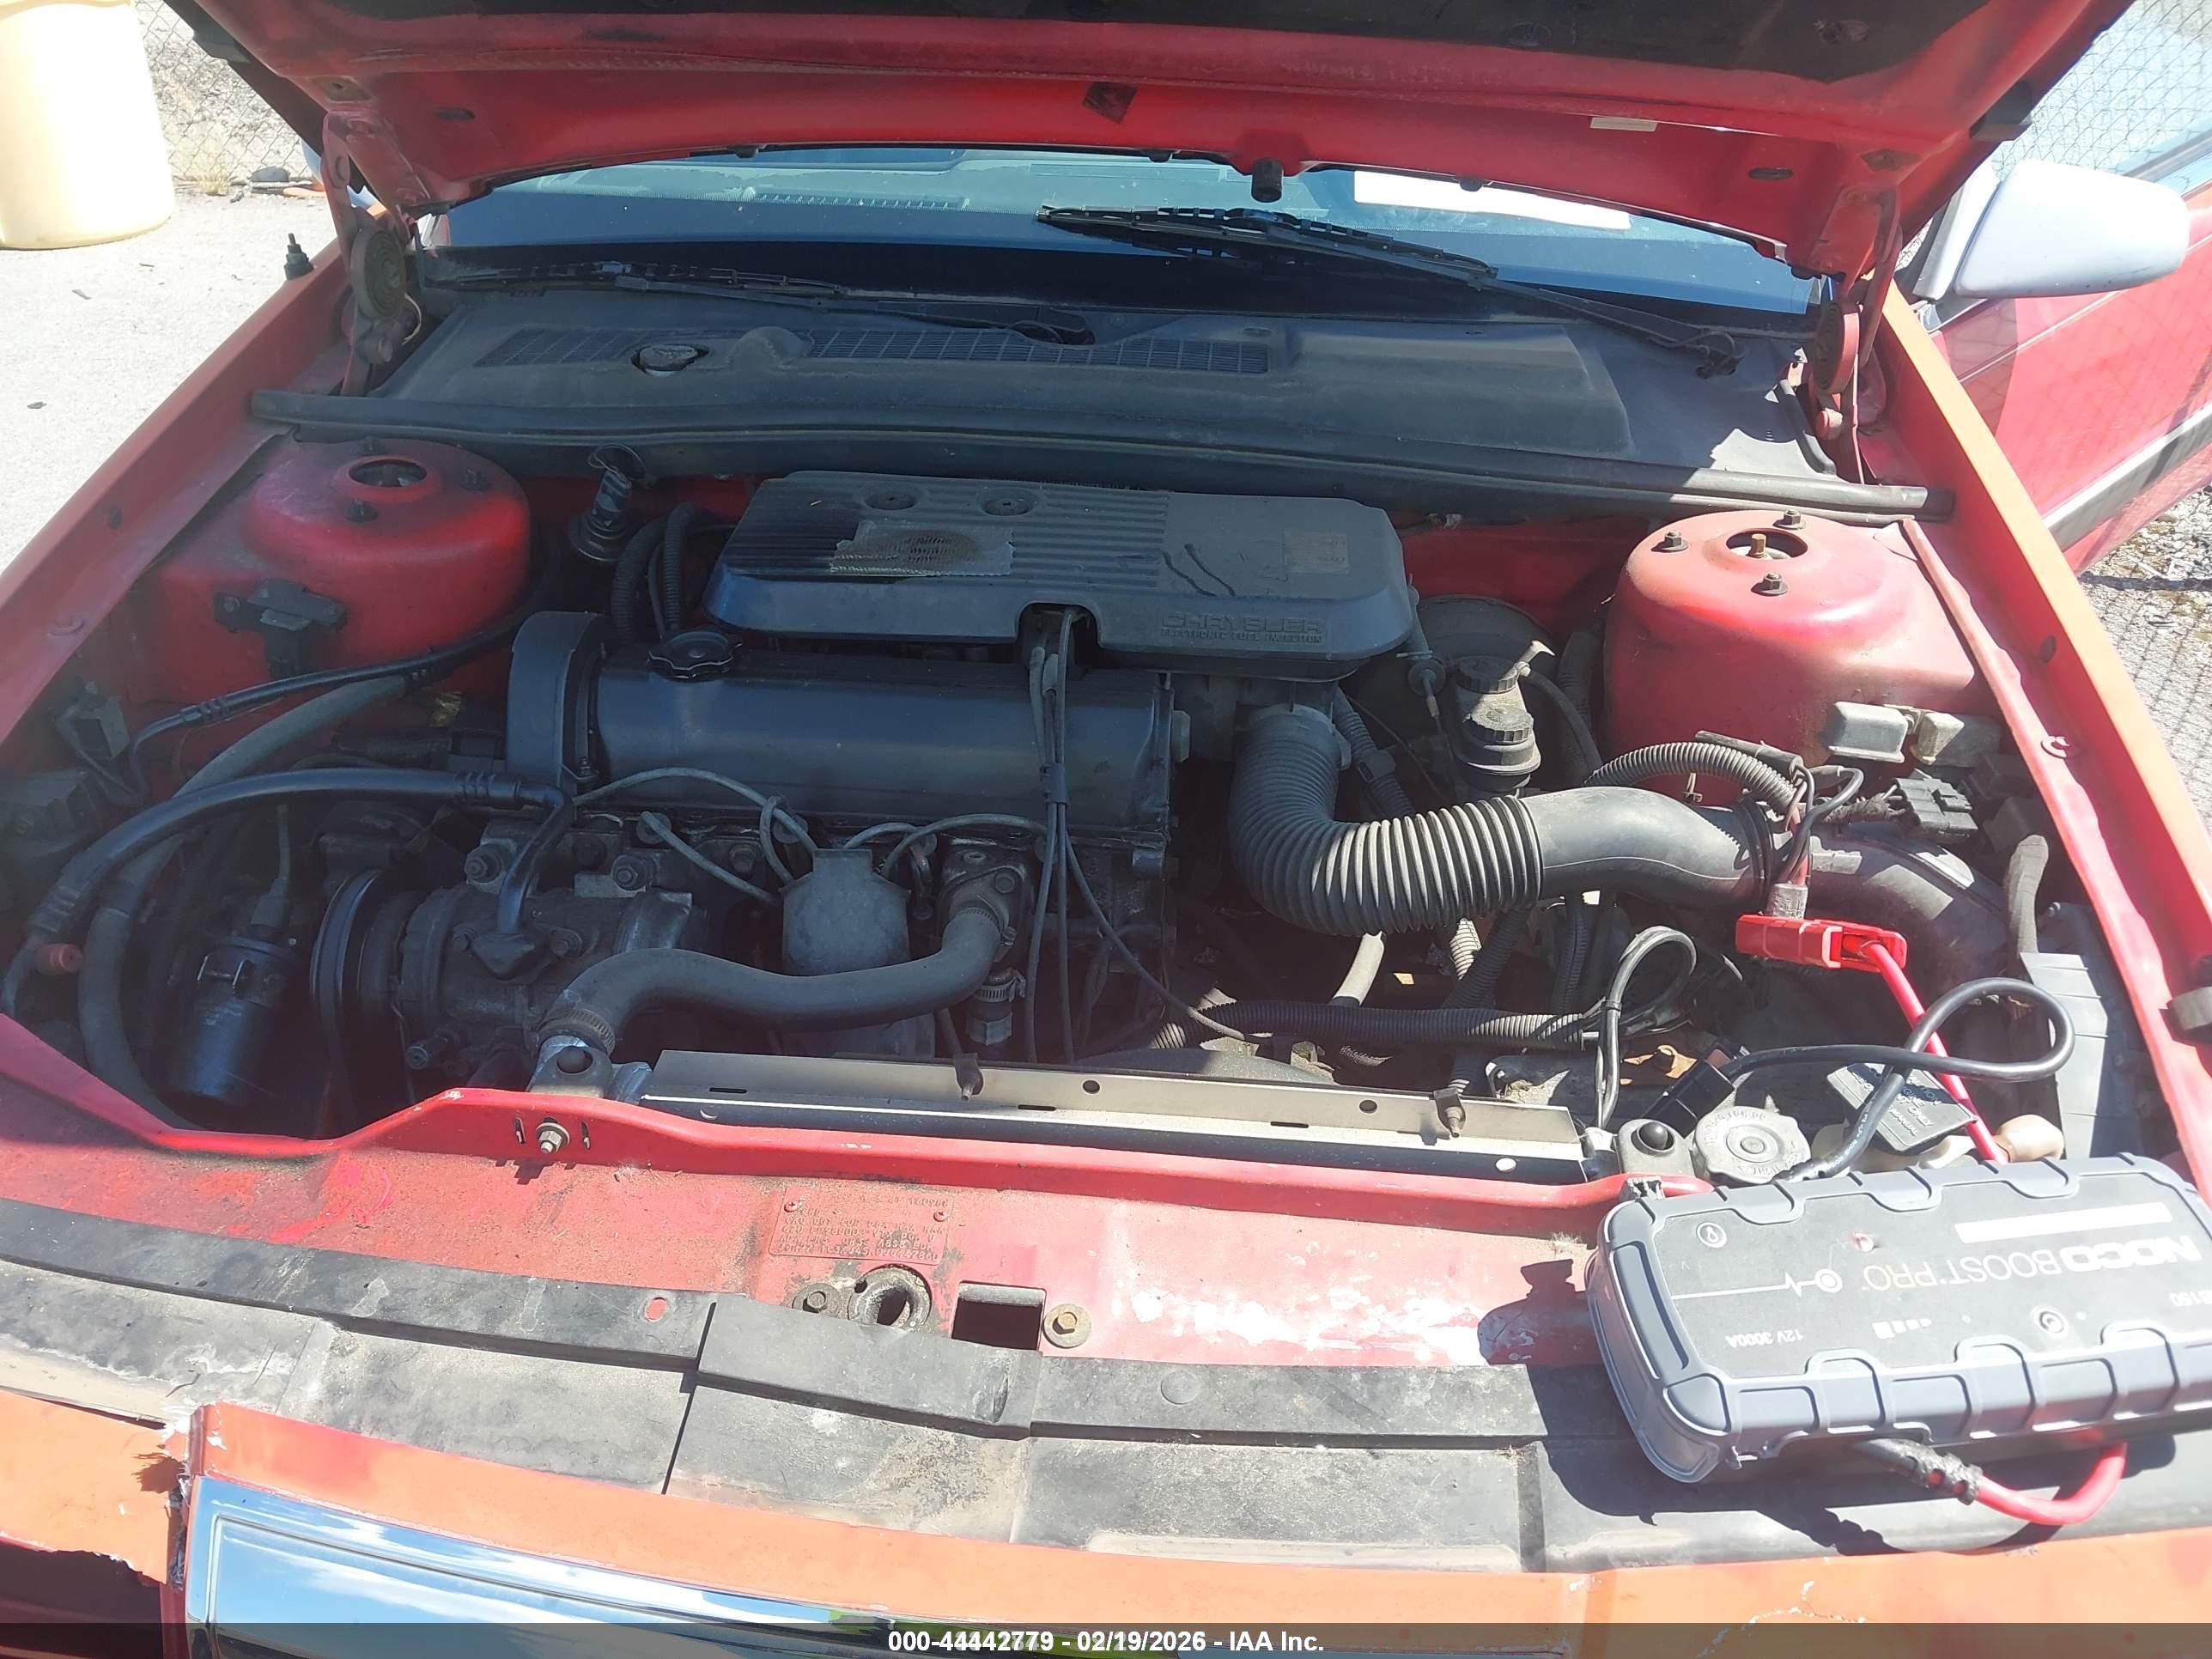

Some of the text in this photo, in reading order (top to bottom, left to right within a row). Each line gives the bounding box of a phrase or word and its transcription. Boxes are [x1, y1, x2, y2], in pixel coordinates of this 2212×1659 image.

[1161, 611, 1322, 633] CHRYSLER
[2063, 1236, 2203, 1273] NOCO
[1725, 1328, 1803, 1349] 12V 3000A
